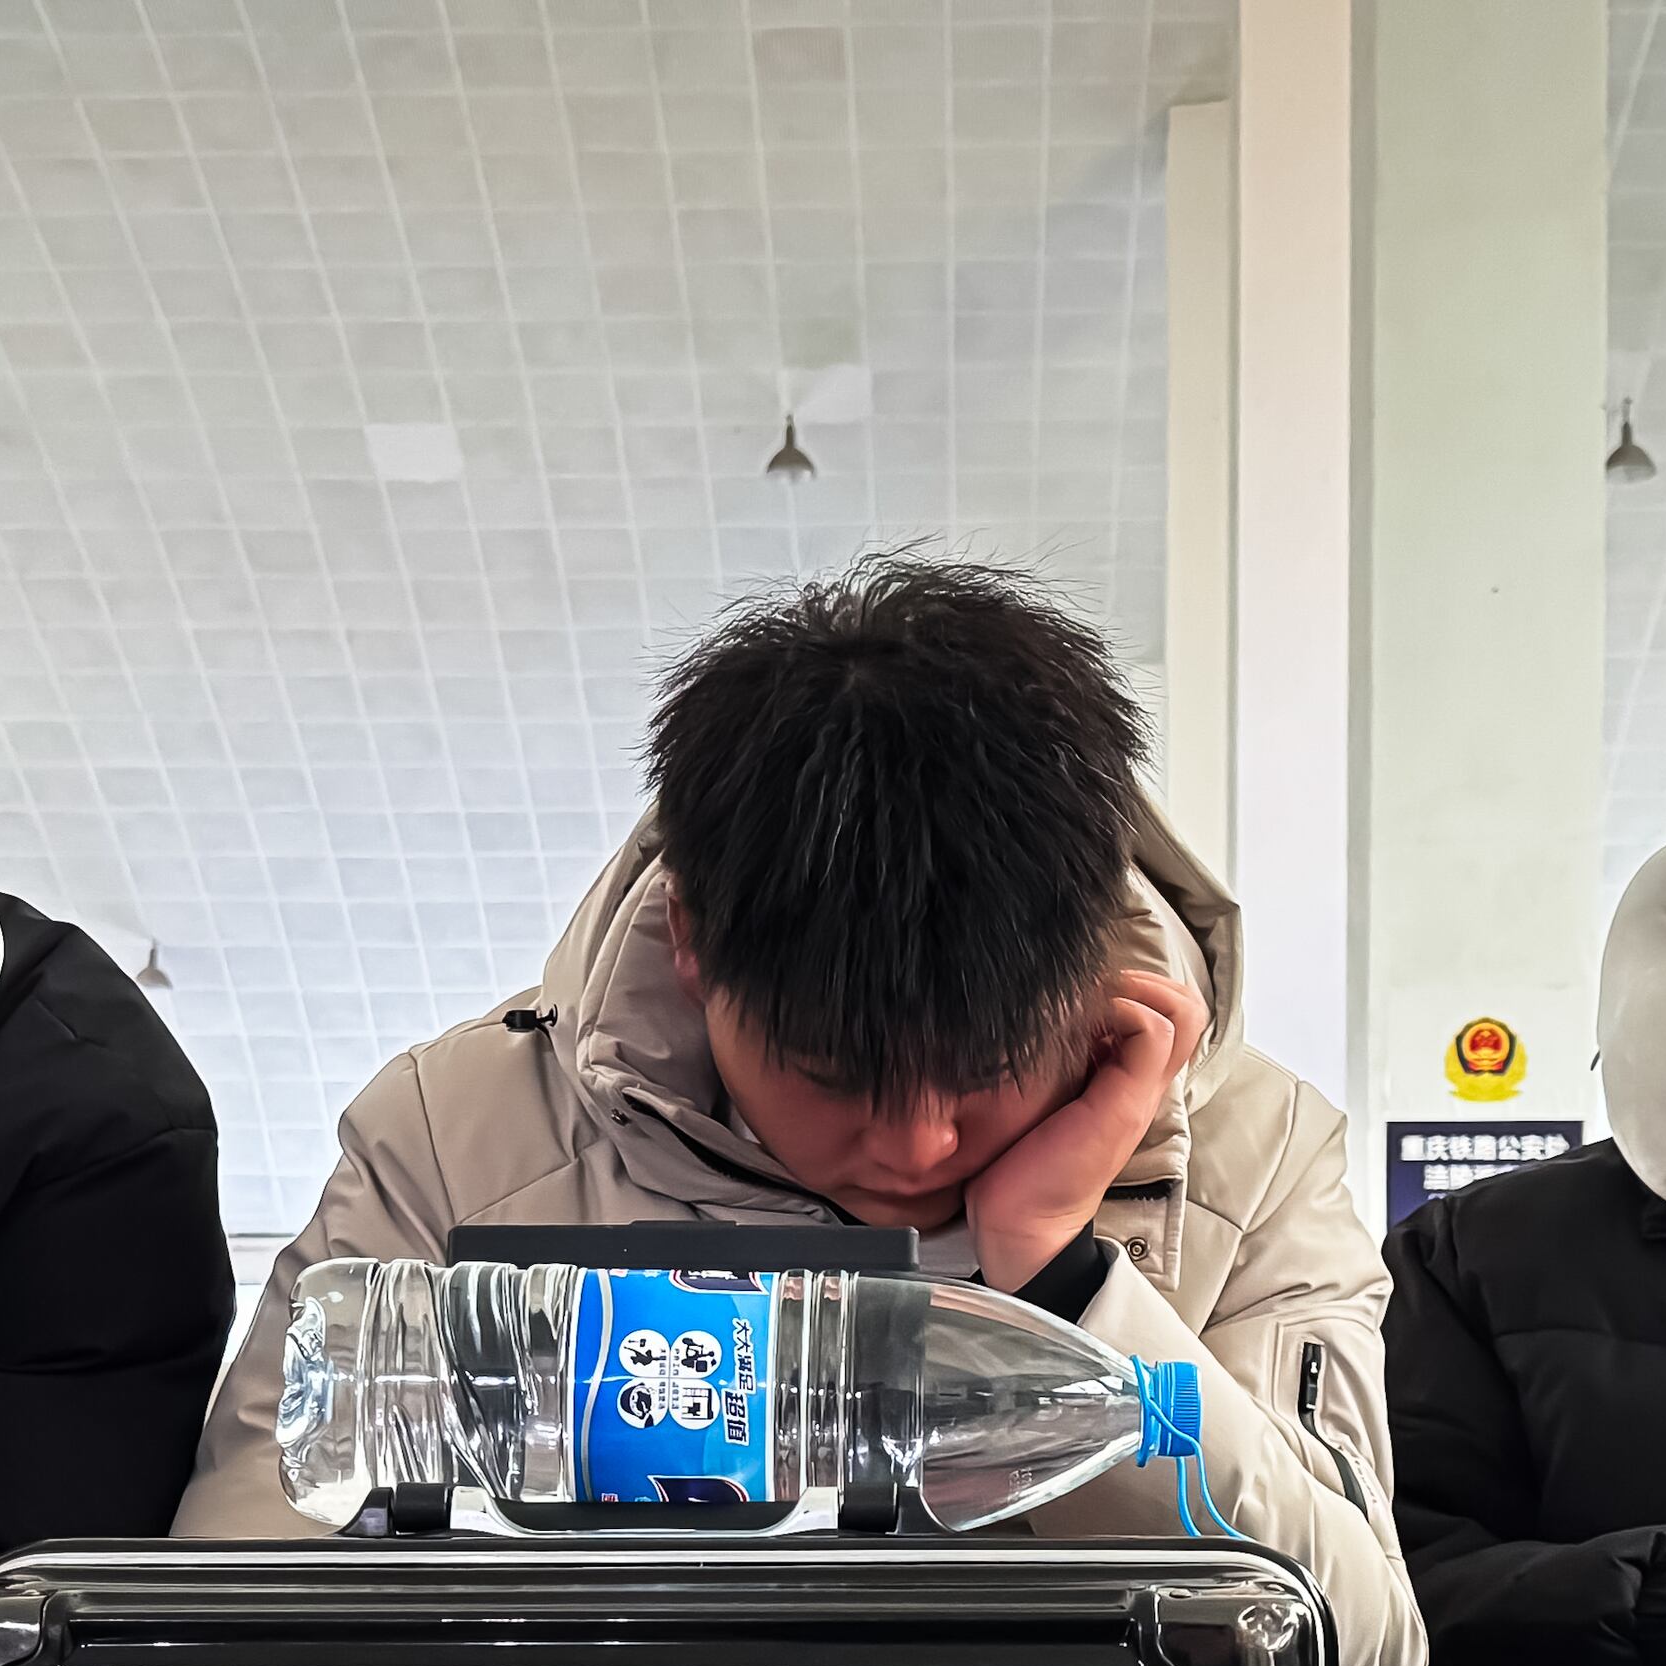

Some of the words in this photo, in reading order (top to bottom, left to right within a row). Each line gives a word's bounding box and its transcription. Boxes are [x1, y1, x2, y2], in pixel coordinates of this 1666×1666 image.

[733, 1320, 755, 1392] 大大满足
[725, 1390, 747, 1442] 超值
